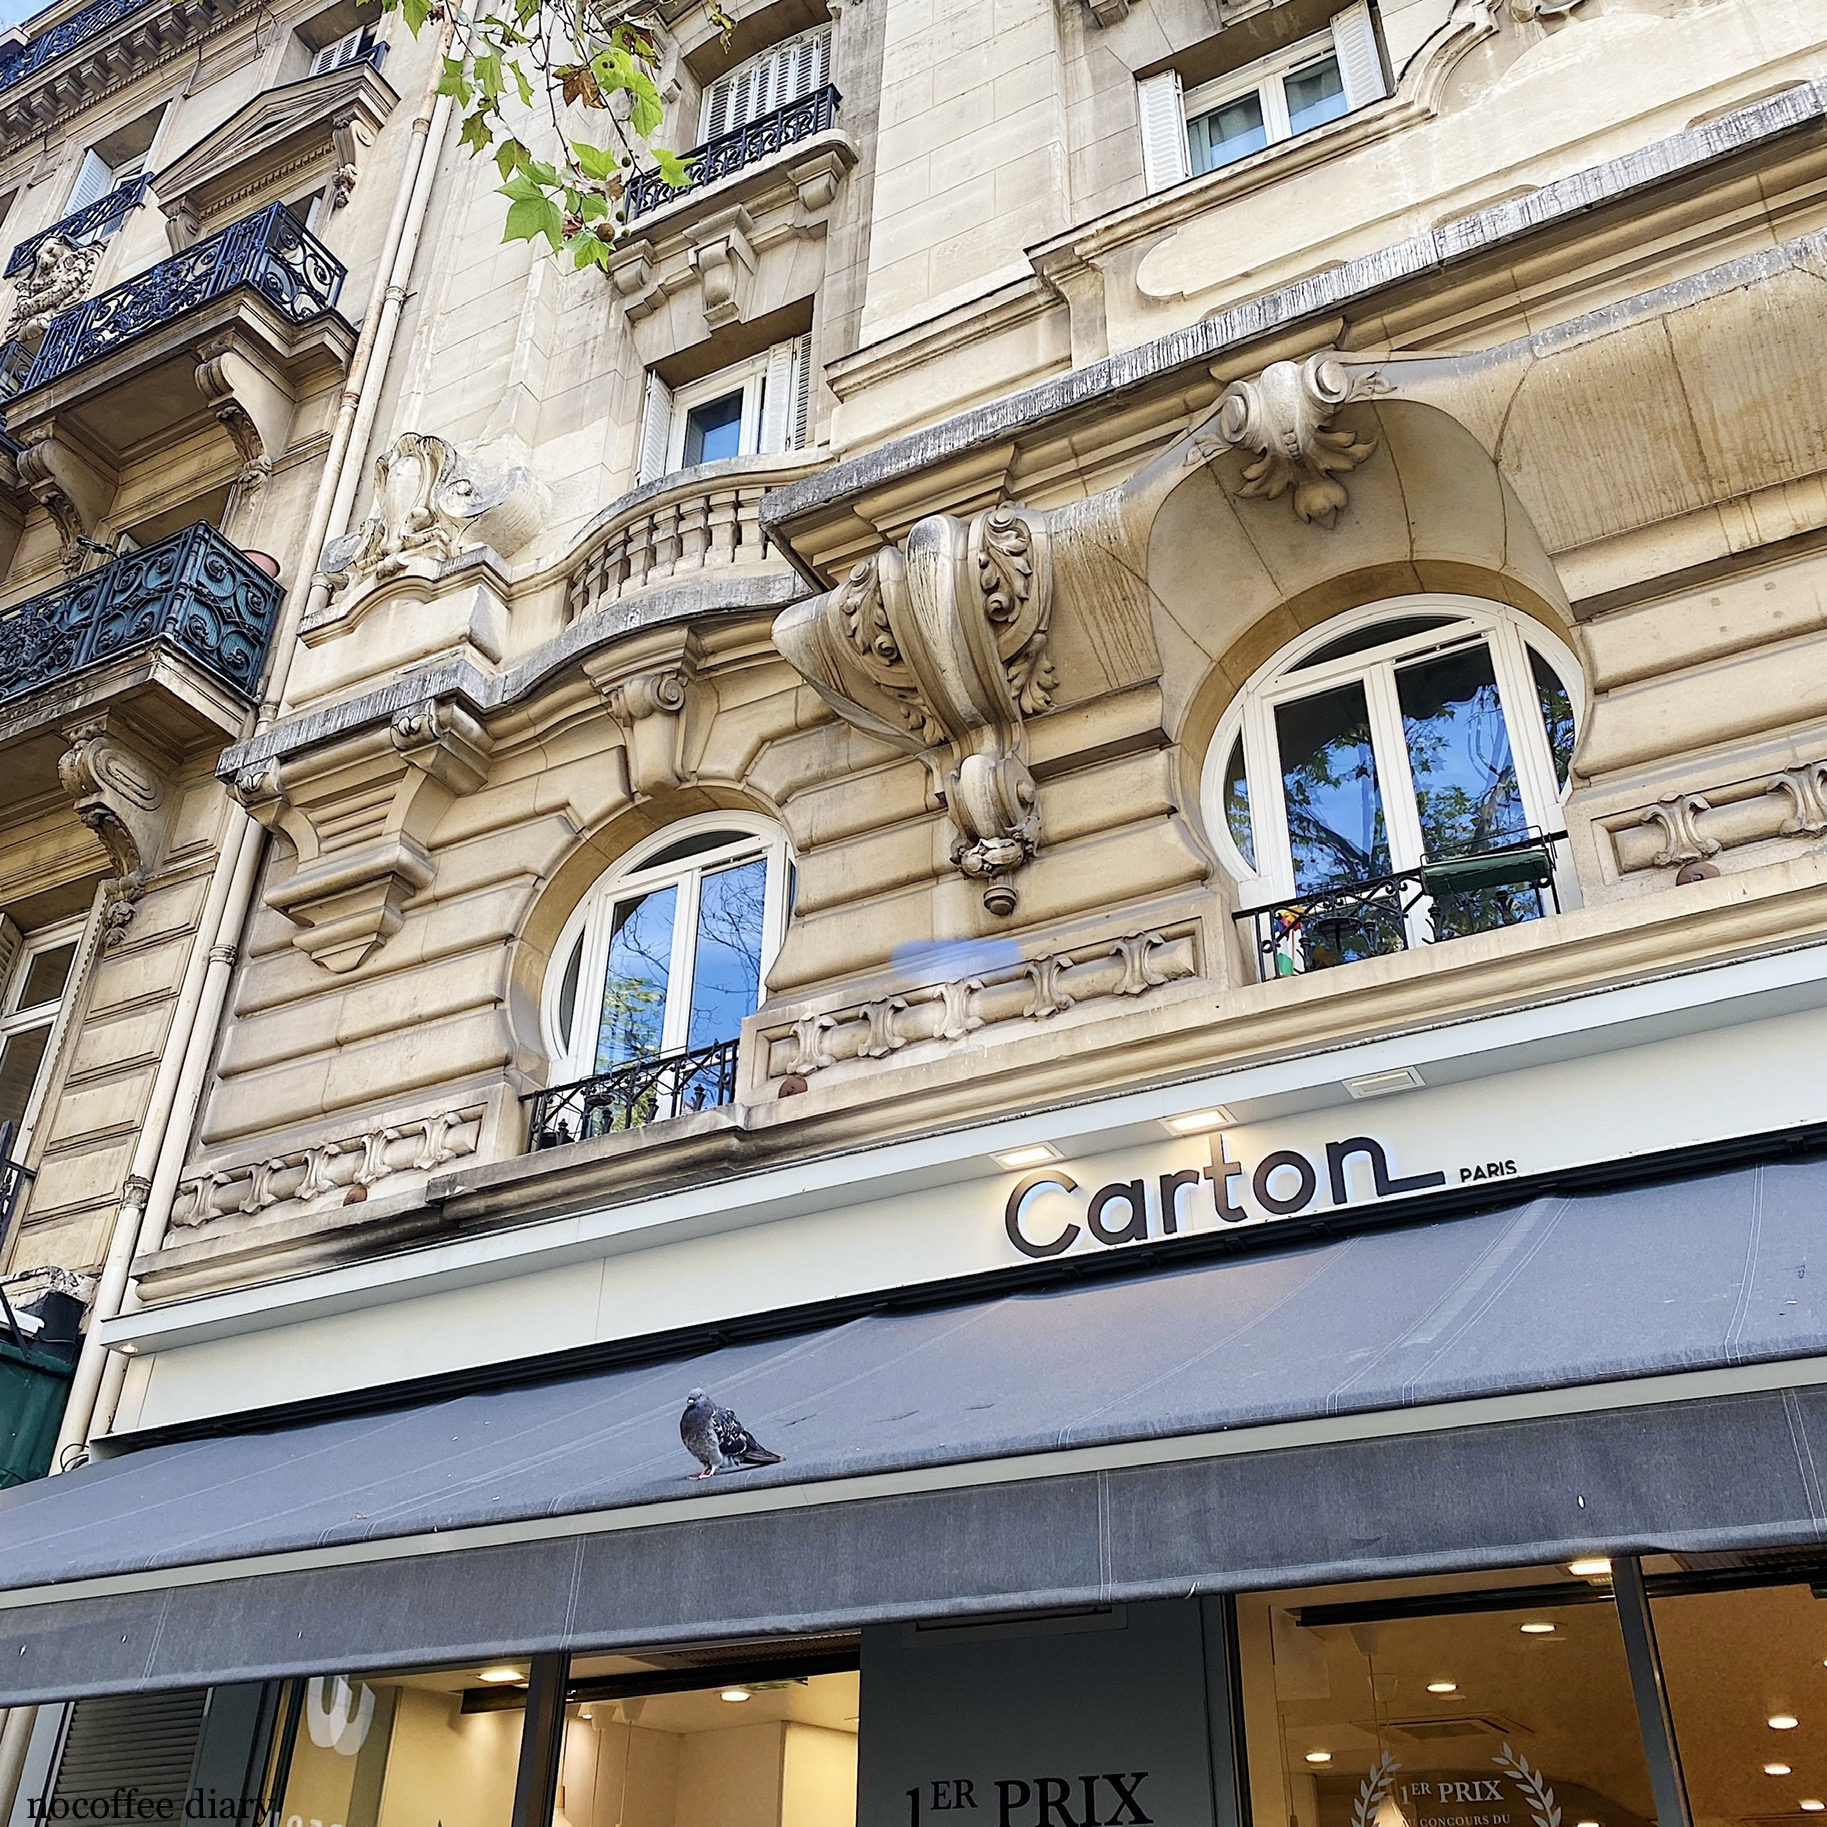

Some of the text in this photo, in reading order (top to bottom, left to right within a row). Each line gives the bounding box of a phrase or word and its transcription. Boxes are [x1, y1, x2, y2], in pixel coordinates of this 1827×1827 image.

[1005, 1133, 1518, 1259] Carton PARIS
[993, 1771, 1155, 1827] PRIX
[1437, 1779, 1505, 1804] PRIX
[1419, 1814, 1490, 1827] CONCOURS
[1493, 1813, 1511, 1826] DU
